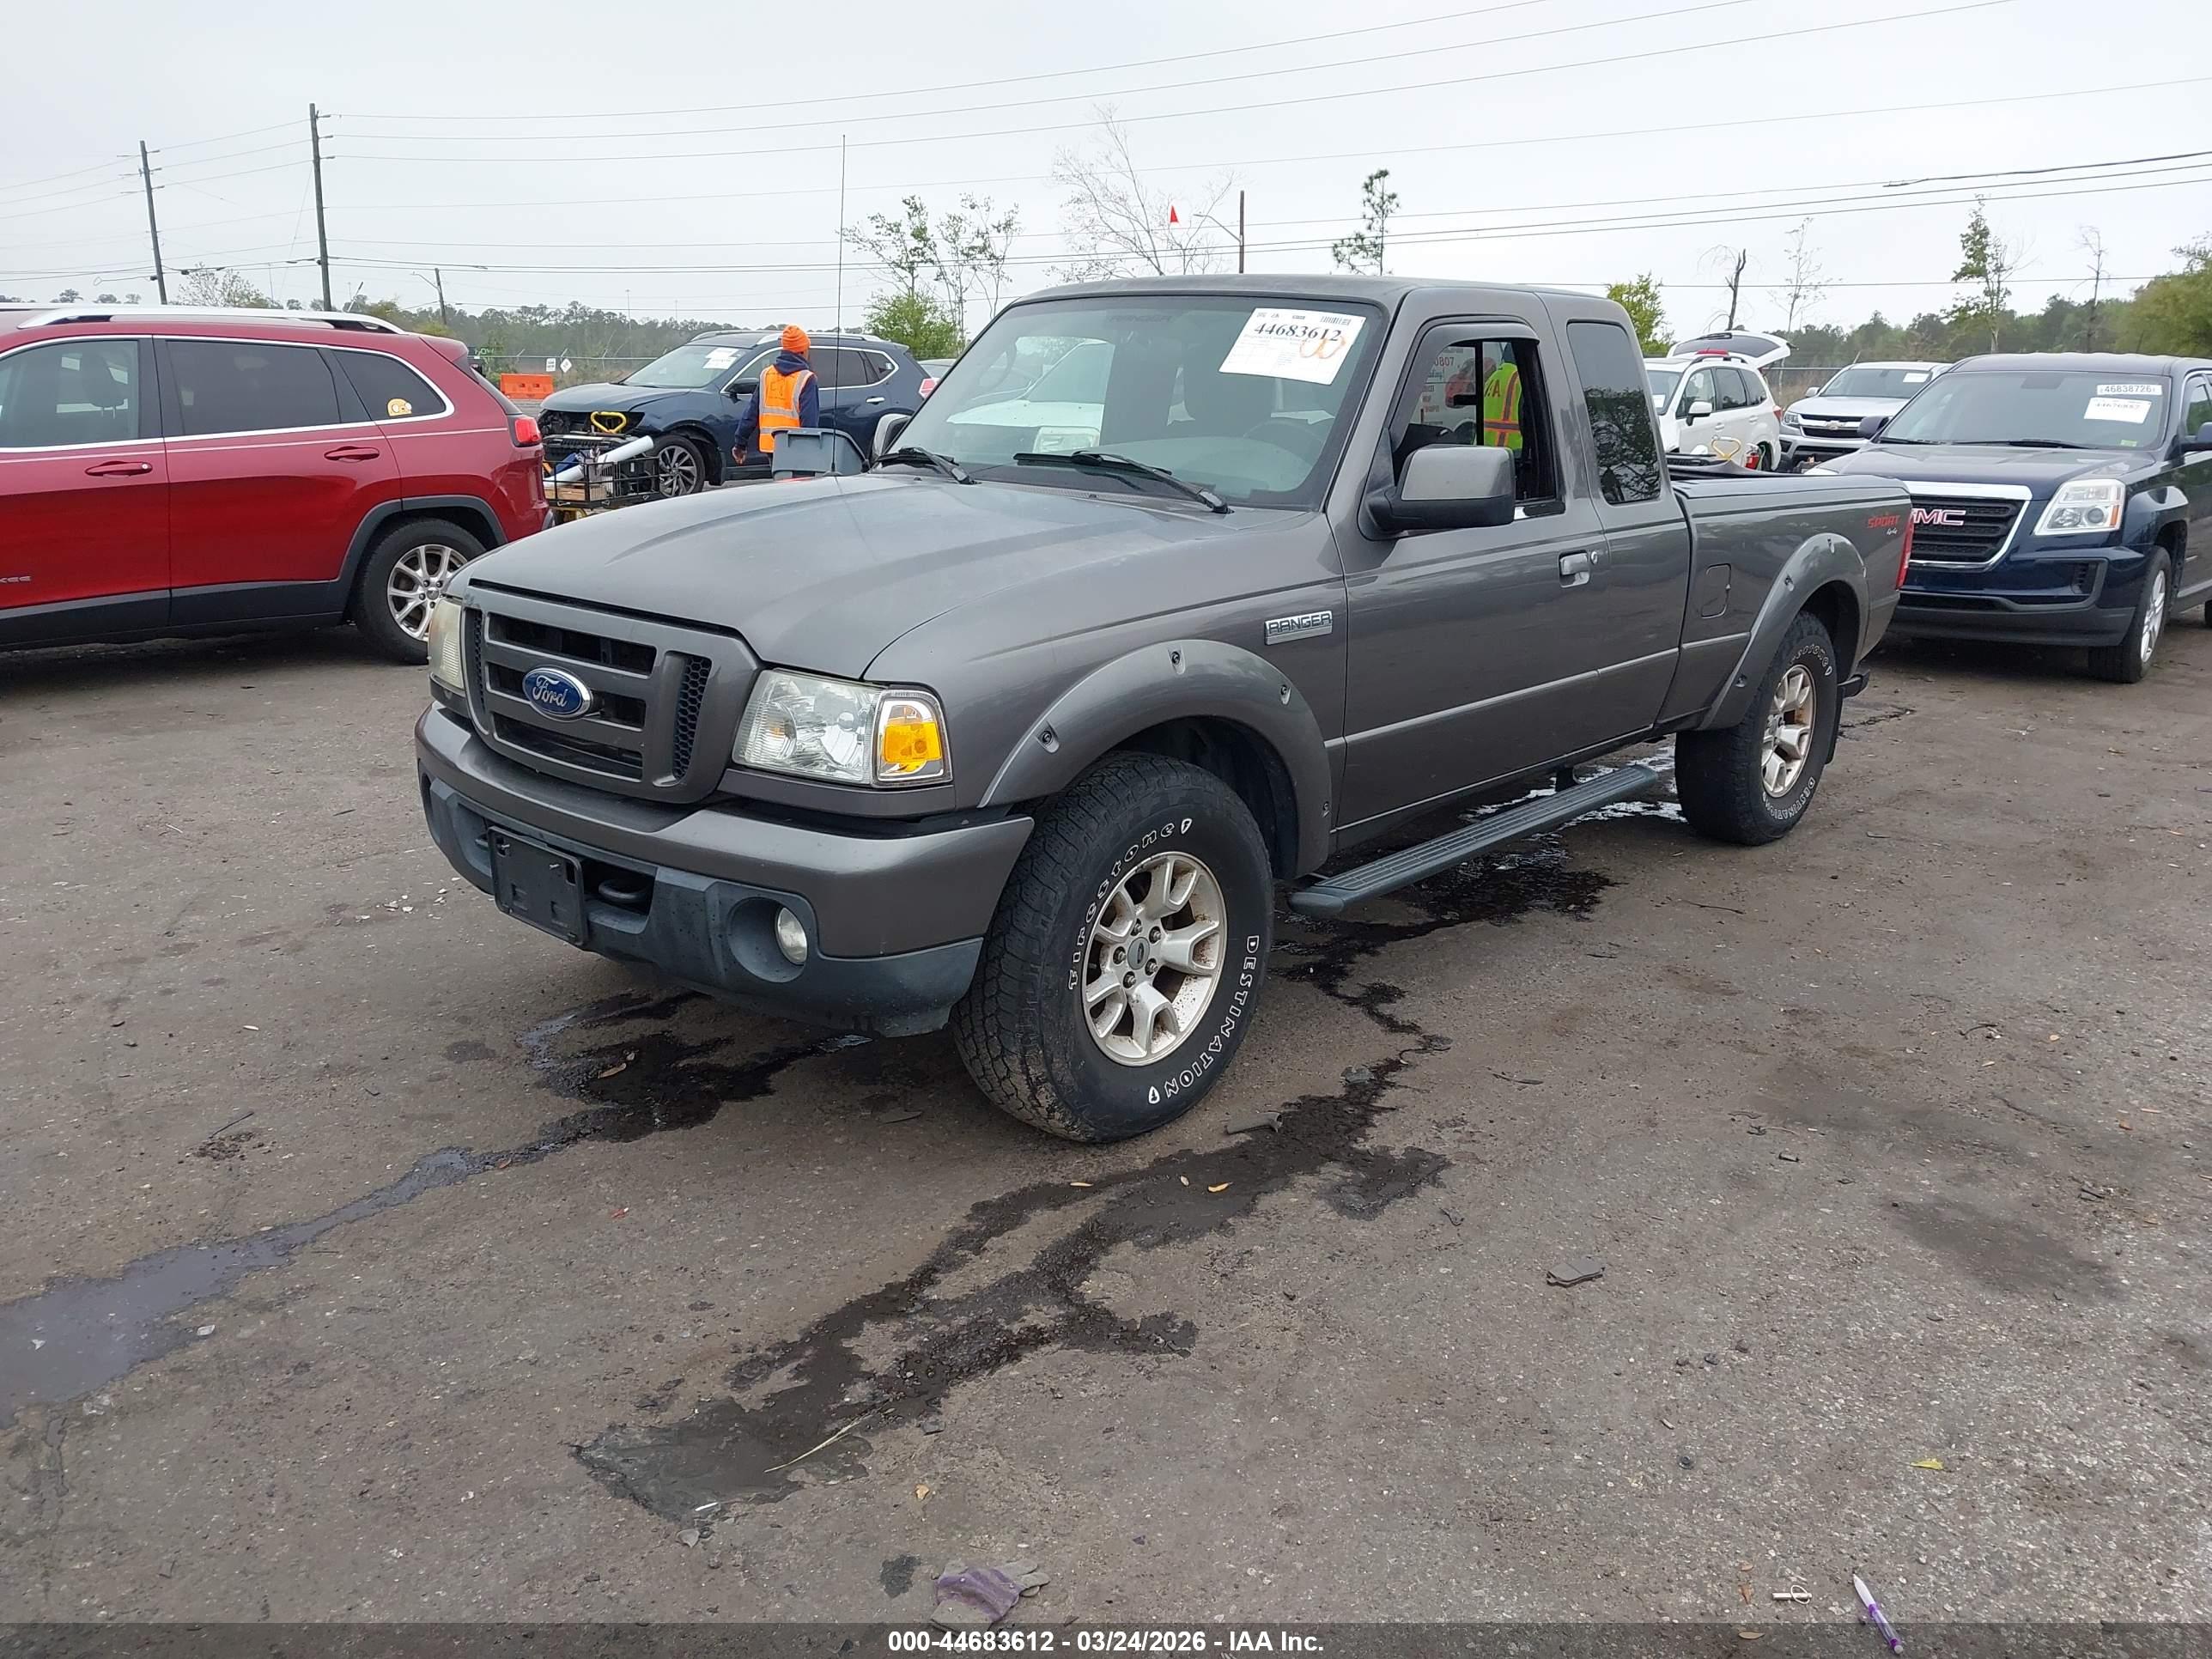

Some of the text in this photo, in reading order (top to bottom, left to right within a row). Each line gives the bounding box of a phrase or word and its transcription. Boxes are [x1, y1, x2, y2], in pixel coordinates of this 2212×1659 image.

[1254, 322, 1342, 342] 44683612
[1911, 508, 1966, 526] MC
[1268, 613, 1331, 634] RANGER
[532, 675, 568, 707] Ford
[1068, 823, 1175, 990] Firestone
[1164, 935, 1260, 1098] DESTINATION
